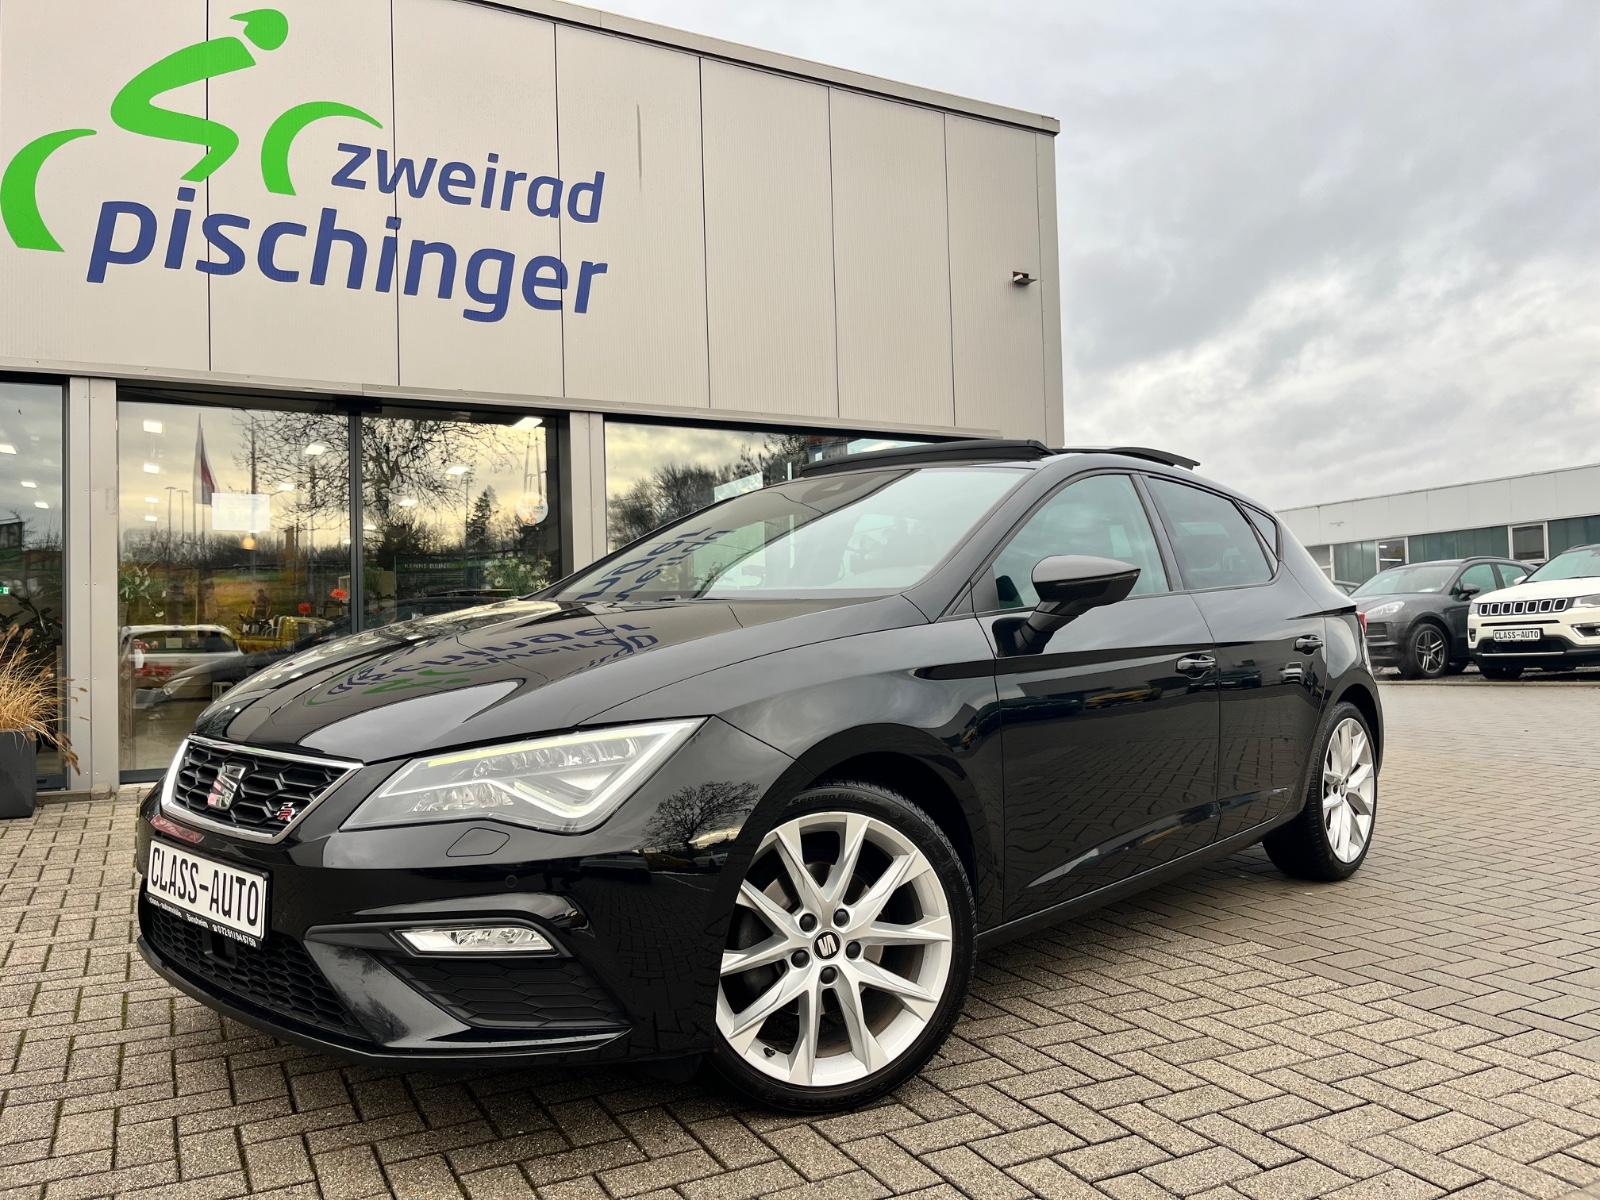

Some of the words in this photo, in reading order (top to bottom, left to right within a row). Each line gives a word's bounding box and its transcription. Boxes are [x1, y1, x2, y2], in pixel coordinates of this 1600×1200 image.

[331, 142, 605, 224] zweirad
[86, 187, 608, 323] pischinger
[1494, 631, 1538, 640] CLASS-AUTO
[151, 847, 259, 926] CLASS-AUTO
